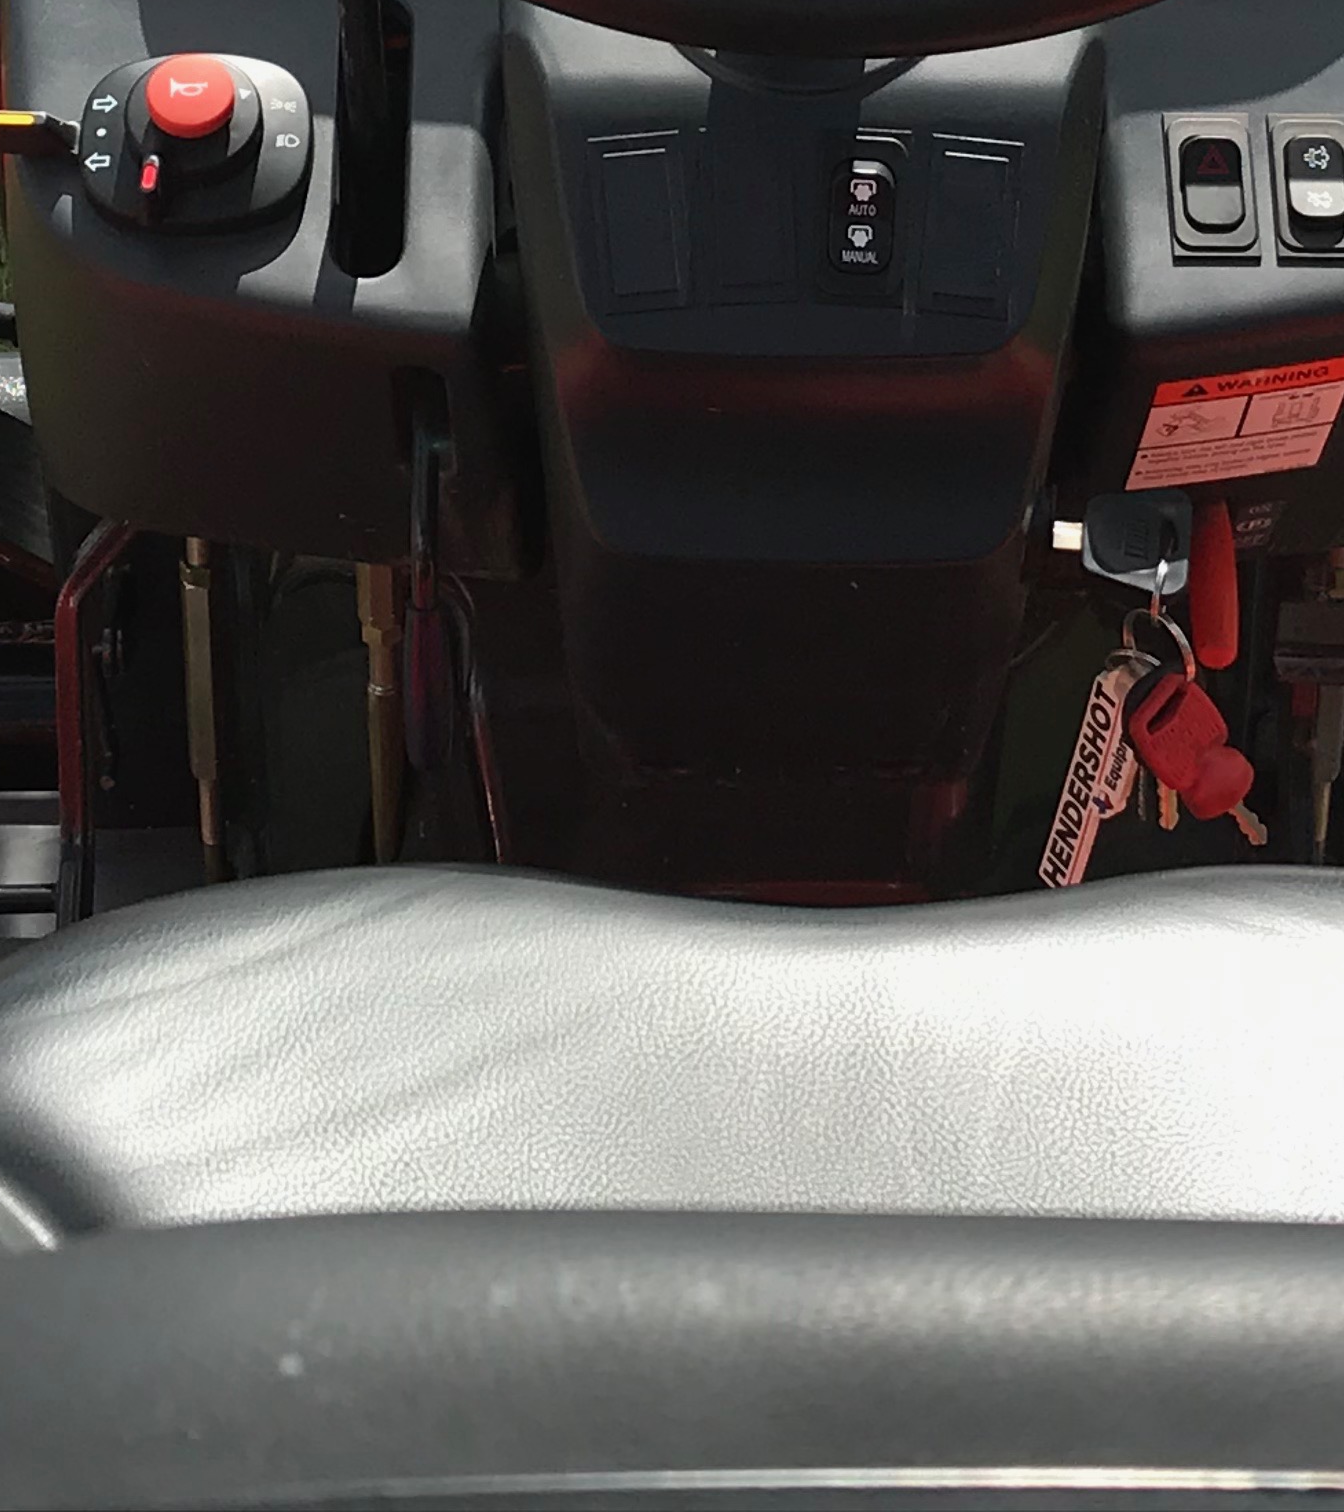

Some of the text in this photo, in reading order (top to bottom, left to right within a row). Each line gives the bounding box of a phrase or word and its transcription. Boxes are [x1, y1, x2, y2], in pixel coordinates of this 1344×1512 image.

[847, 203, 877, 217] AUTO
[841, 249, 879, 265] MANUAL
[1216, 364, 1330, 392] WARNING
[1042, 681, 1117, 888] HENDERSHOT
